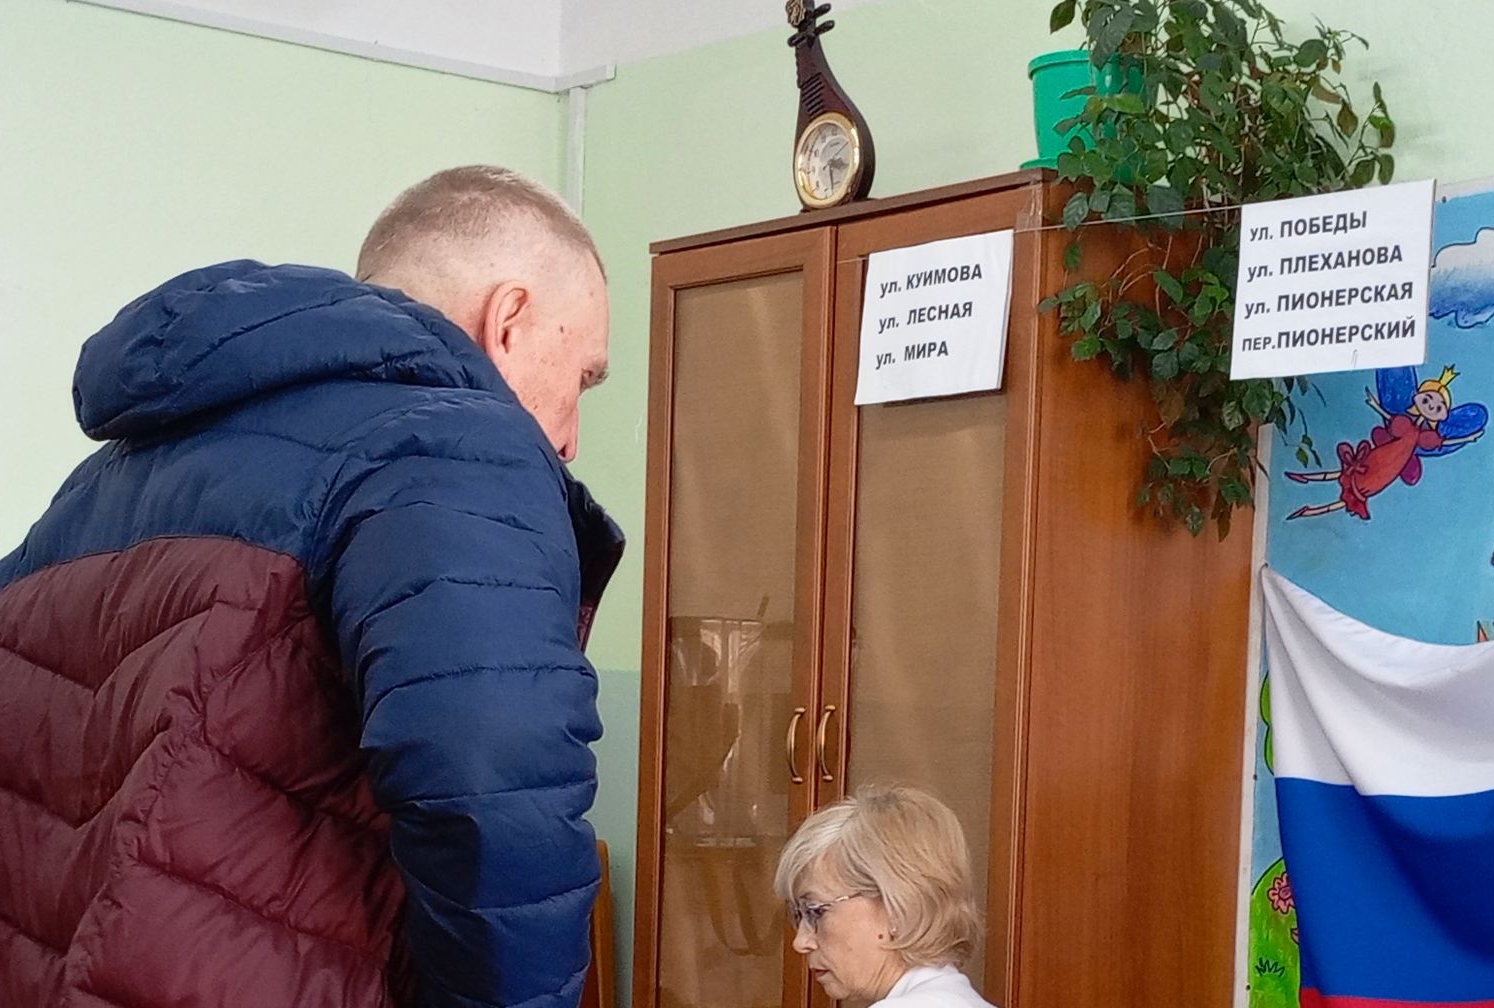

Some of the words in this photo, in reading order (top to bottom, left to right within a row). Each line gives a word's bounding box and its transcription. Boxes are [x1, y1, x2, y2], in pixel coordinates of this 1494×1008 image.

[1249, 226, 1274, 242] ул.
[1279, 210, 1368, 238] ПОБЕДЫ
[879, 280, 902, 299] ул.
[906, 263, 983, 291] КУИМОВА
[1246, 264, 1273, 283] ул.
[1279, 245, 1403, 275] ПЛЕХАНОВА
[1244, 301, 1271, 319] ул.
[1276, 281, 1414, 313] ПИОНЕРСКАЯ
[878, 316, 900, 334] ул.
[906, 301, 973, 326] ЛЕСНАЯ
[875, 352, 896, 370] ул.
[904, 340, 949, 362] МИРА
